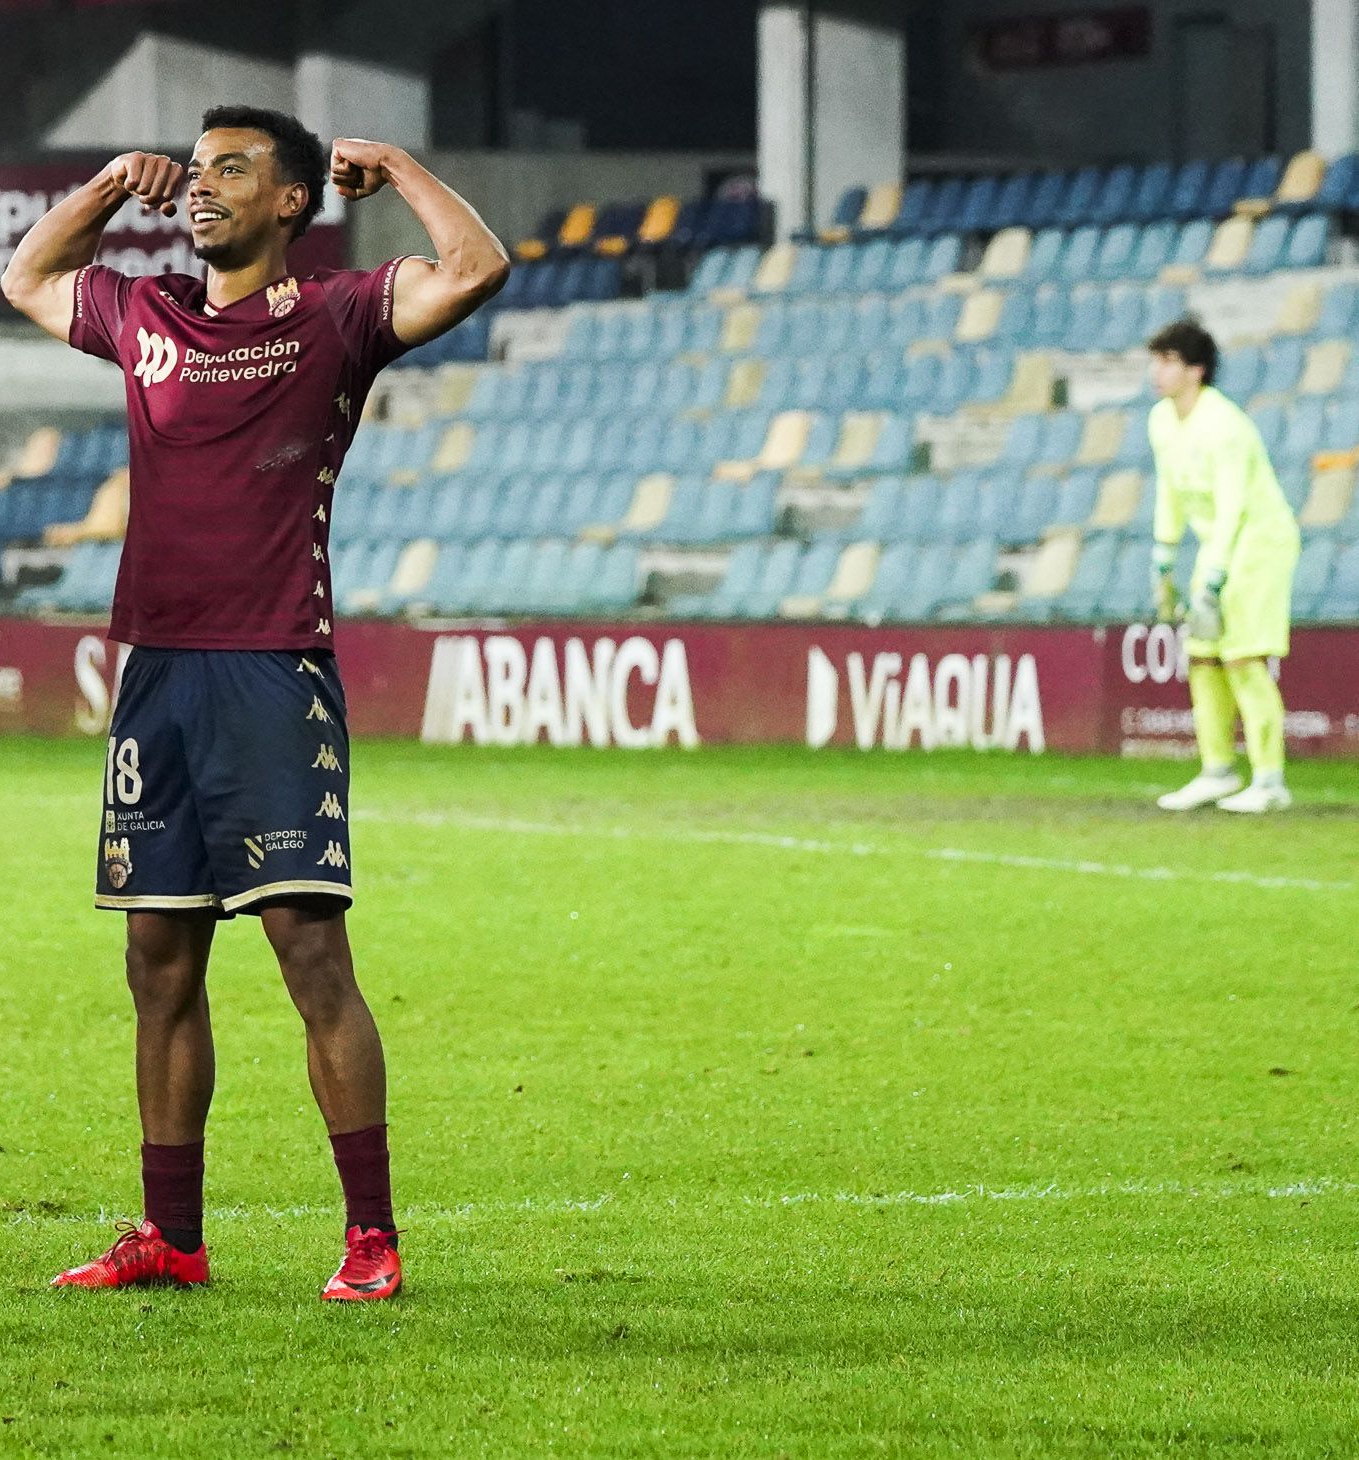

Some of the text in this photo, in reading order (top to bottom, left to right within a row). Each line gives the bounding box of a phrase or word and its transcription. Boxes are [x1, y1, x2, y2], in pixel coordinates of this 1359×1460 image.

[184, 338, 300, 369] Deputación
[179, 361, 297, 383] Pontevedra
[107, 736, 143, 805] 18
[117, 811, 144, 821] XUNTA
[117, 821, 165, 831] DE GALICIA
[265, 830, 307, 841] DEPORTE
[266, 840, 304, 851] GALEGO
